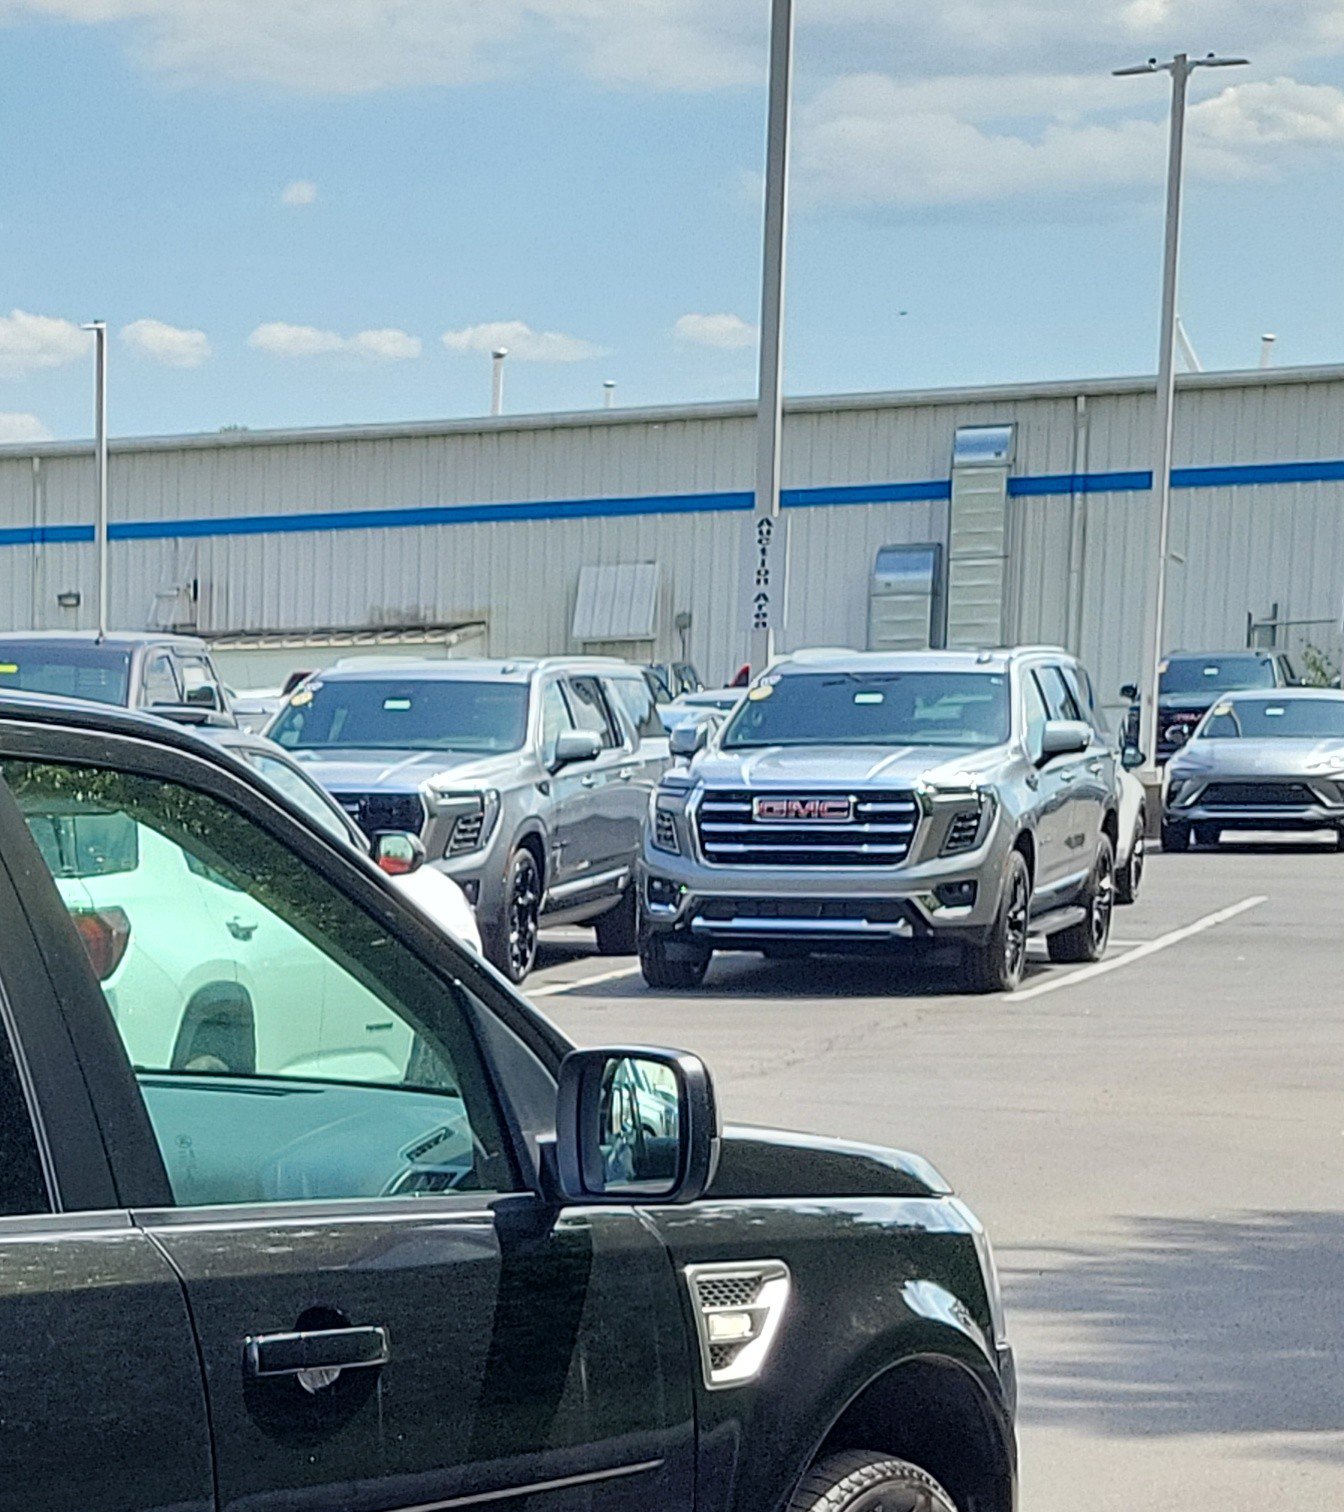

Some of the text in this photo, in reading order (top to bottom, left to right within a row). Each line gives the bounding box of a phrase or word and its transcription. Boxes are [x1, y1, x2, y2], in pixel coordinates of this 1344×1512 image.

[753, 516, 774, 630] Auction Area
[758, 799, 850, 819] GMC
